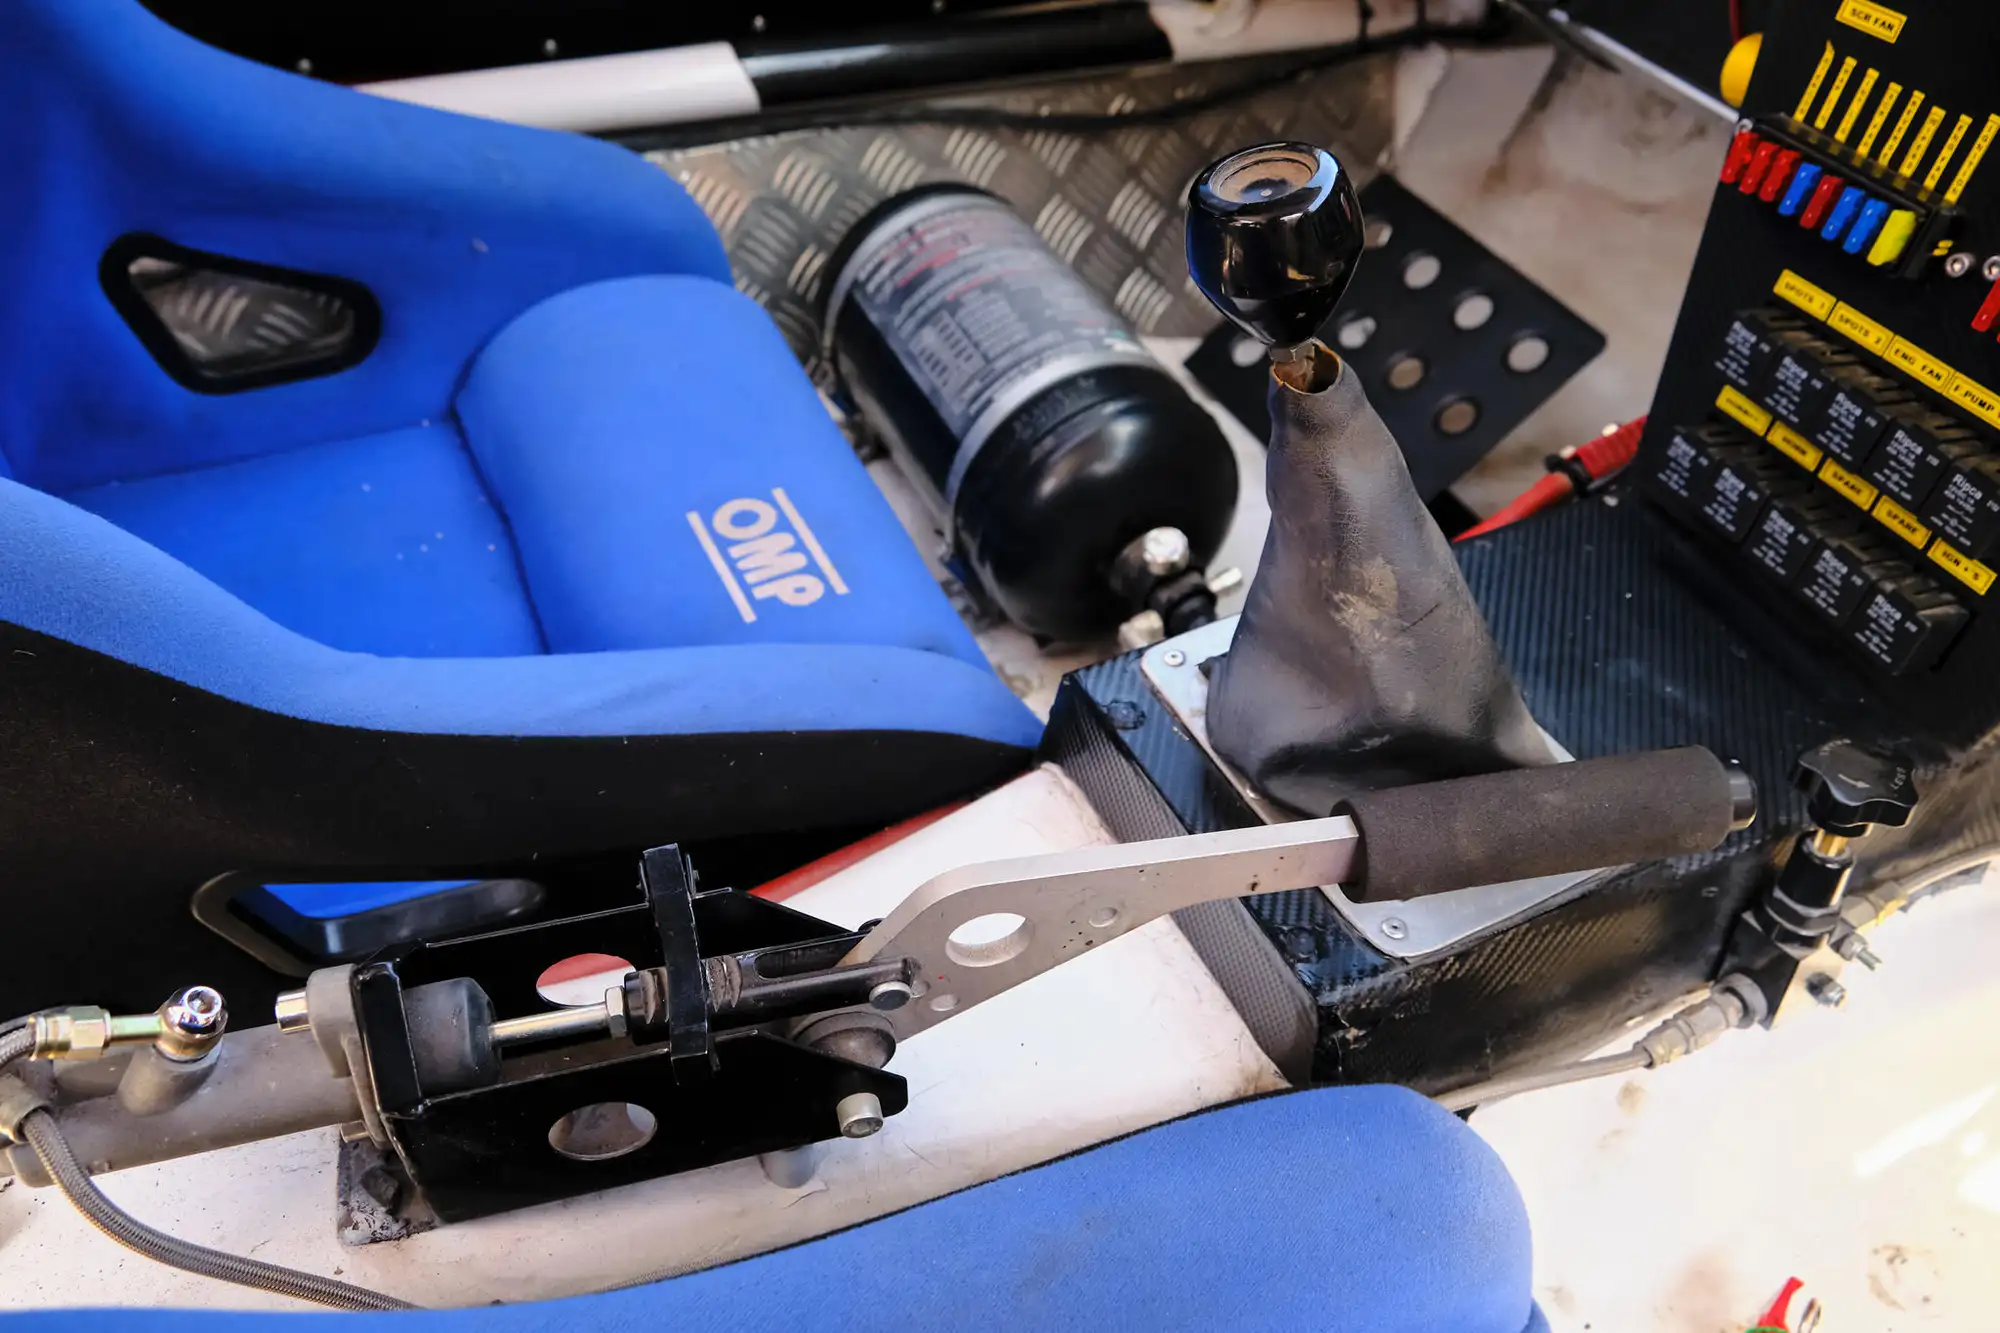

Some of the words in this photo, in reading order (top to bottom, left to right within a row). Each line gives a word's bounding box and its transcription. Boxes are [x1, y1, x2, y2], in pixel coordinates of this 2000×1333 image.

[1873, 17, 1894, 32] FAN
[1951, 125, 1993, 195] IGNITION
[1838, 313, 1870, 337] SPOTS
[1894, 348, 1916, 366] ENG
[1921, 364, 1942, 382] FAN
[1963, 390, 1995, 412] PUMP
[1831, 471, 1862, 496] SPARE
[1952, 473, 1983, 500] Ripca
[1885, 508, 1918, 534] SPARE
[711, 498, 825, 607] OMP
[1942, 550, 1961, 567] IGN
